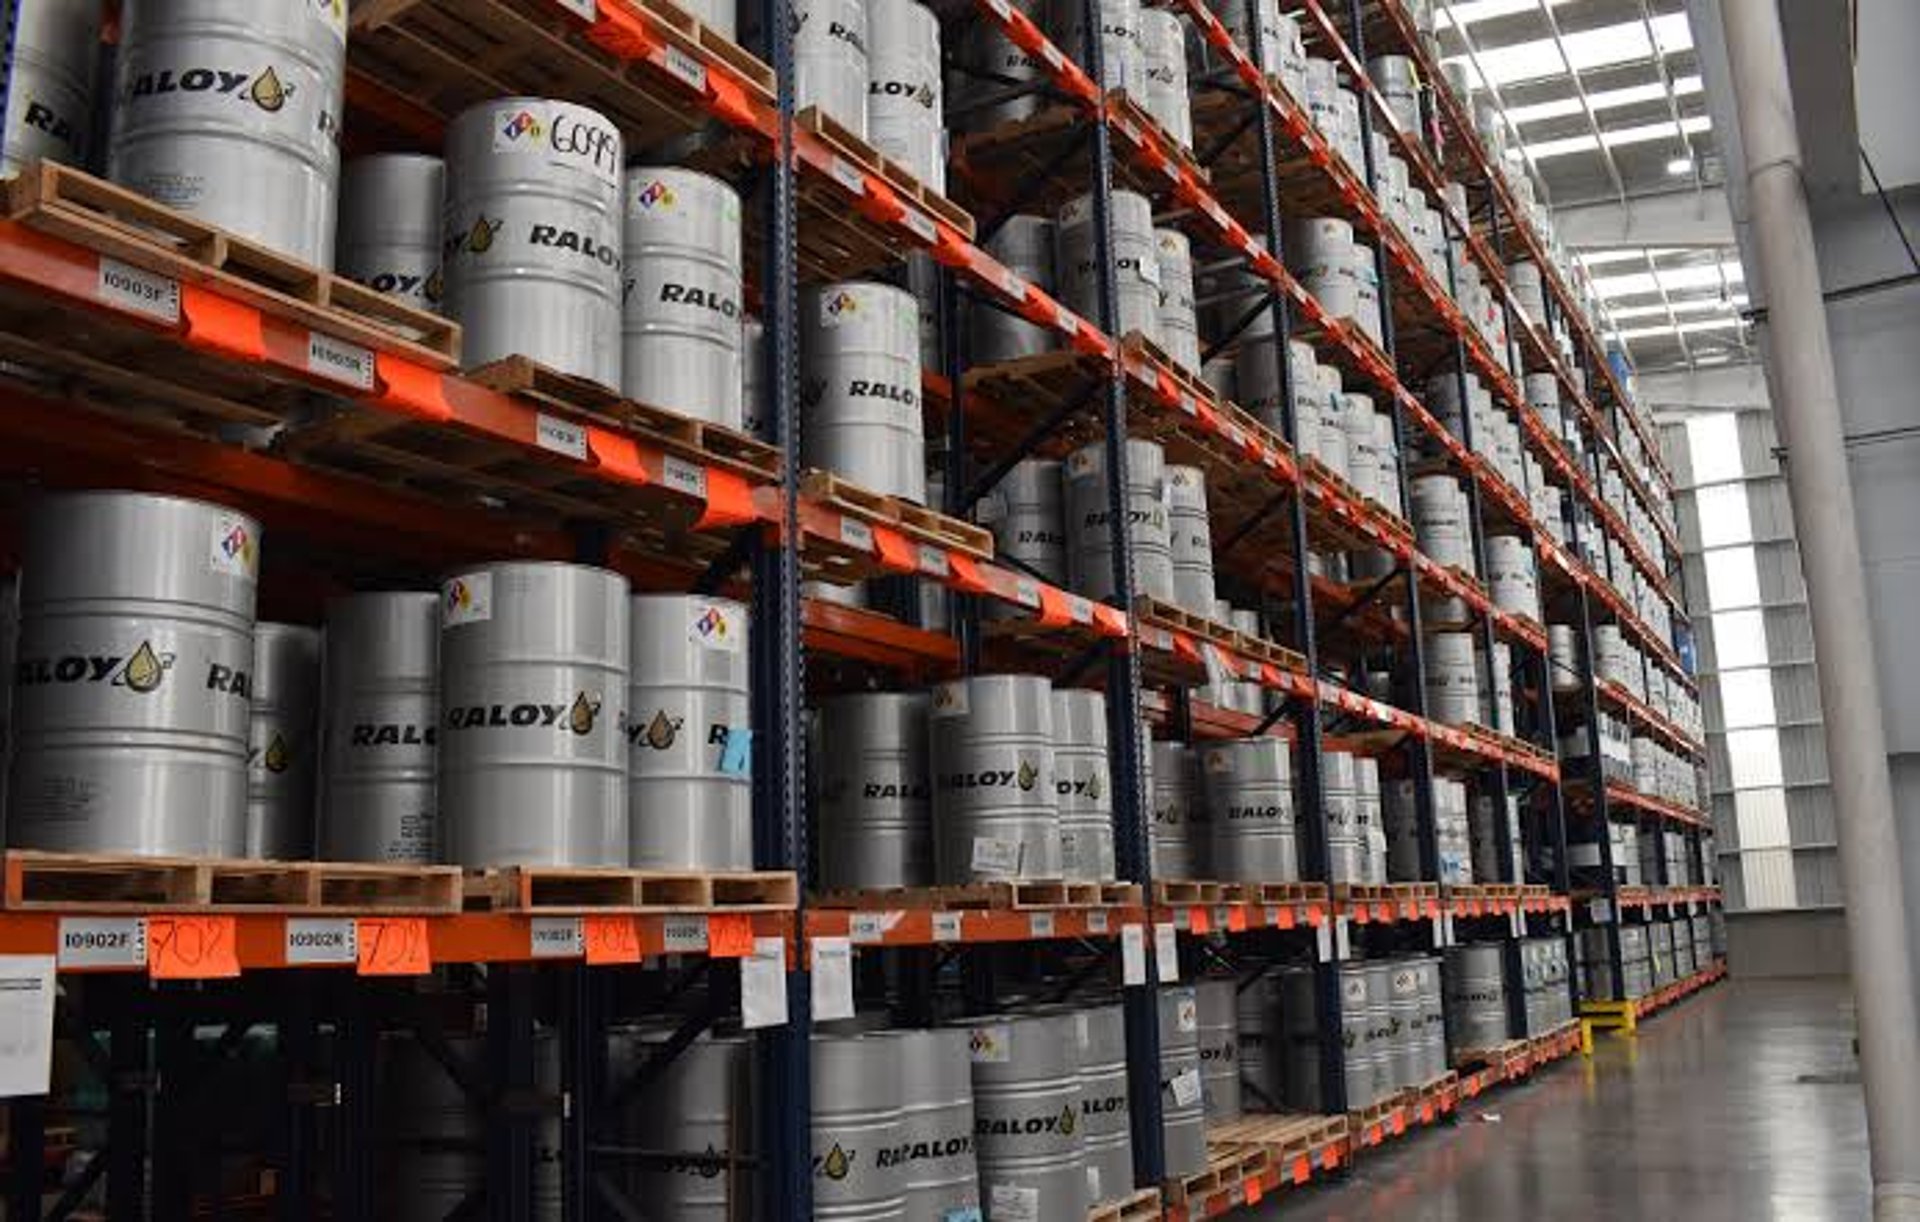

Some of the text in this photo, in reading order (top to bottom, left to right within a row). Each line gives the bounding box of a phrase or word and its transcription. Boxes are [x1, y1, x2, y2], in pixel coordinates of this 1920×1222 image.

[660, 283, 736, 317] RALO
[849, 381, 916, 406] RALO
[449, 704, 566, 731] RALOY
[975, 1116, 1058, 1135] RALOY
